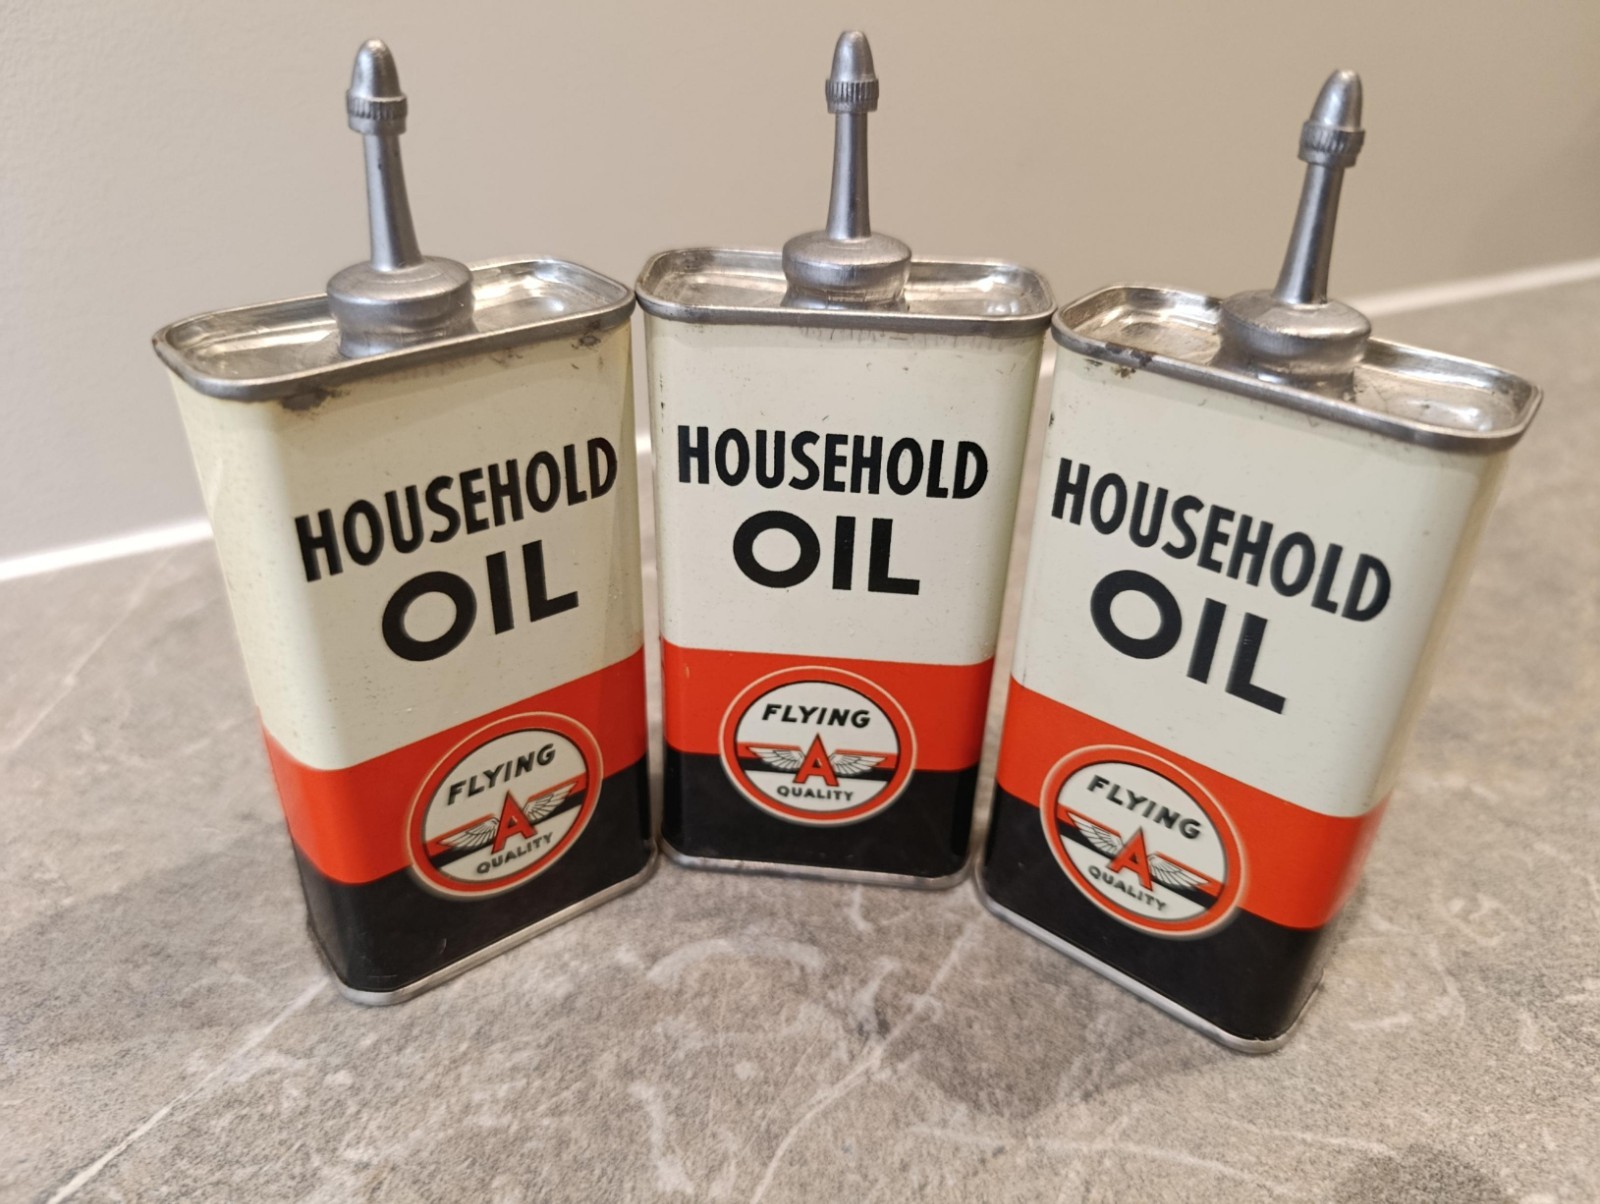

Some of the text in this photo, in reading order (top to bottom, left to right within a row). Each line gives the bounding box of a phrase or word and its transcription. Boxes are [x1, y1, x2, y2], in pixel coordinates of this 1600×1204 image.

[678, 425, 988, 500] HOUSEHOLD
[295, 437, 618, 583] HOUSEHOLD
[1052, 457, 1391, 622] HOUSEHOLD
[733, 511, 920, 595] OIL
[382, 540, 579, 661] OIL
[1092, 569, 1286, 714] OIL
[762, 703, 871, 729] FLYING
[447, 743, 556, 806] FLYING
[793, 733, 839, 787] A
[490, 789, 538, 855] A
[777, 785, 854, 802] QUALITY
[1087, 774, 1202, 840] FLYING
[476, 832, 554, 875] QUALITY
[1106, 827, 1153, 892] A
[1087, 864, 1167, 912] QUALITY
